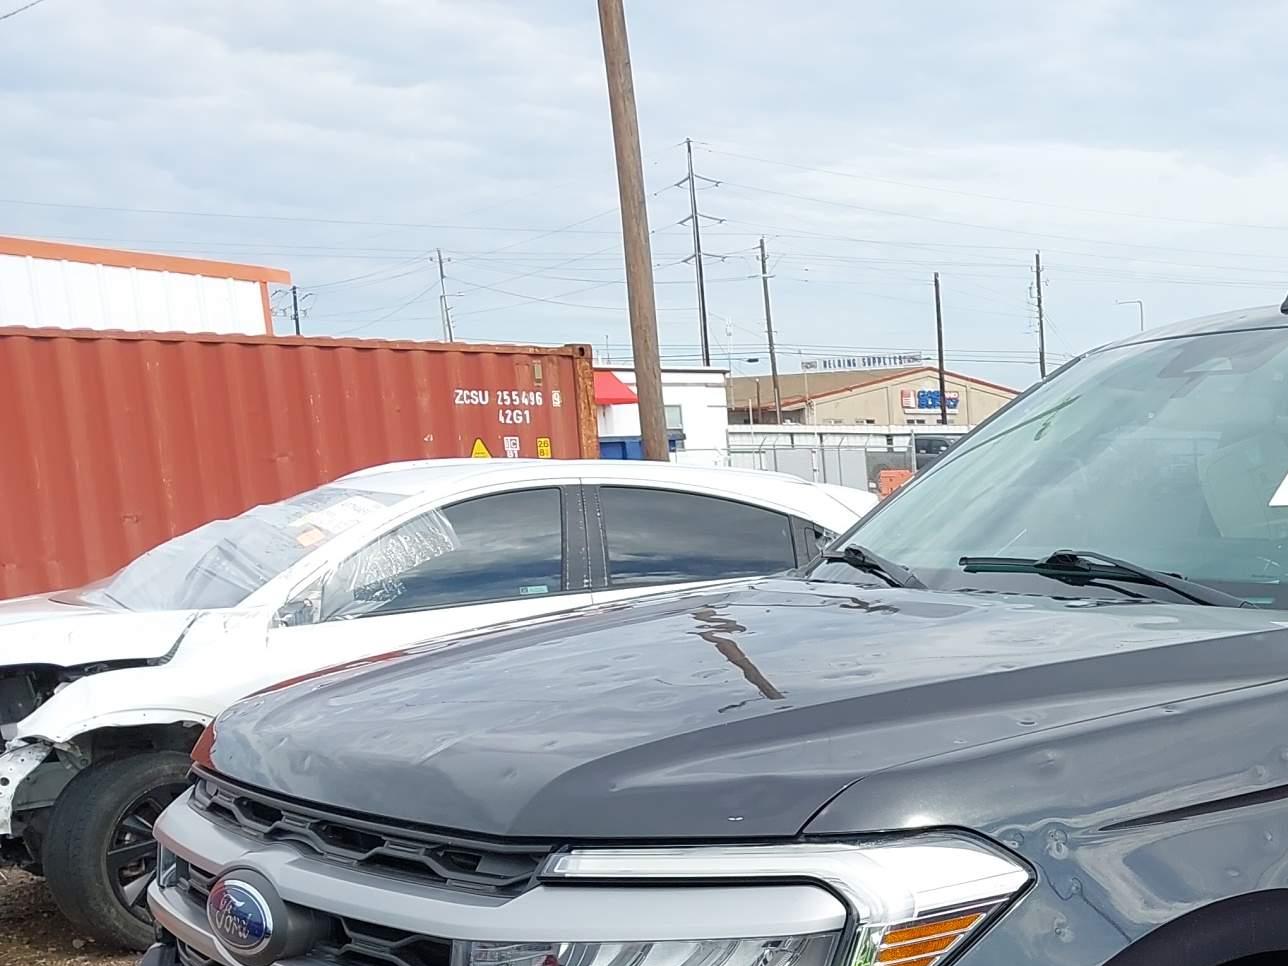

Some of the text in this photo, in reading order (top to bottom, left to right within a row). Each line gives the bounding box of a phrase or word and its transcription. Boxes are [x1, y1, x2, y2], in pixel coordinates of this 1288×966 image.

[862, 355, 903, 367] SUPPLIES
[455, 389, 561, 406] ZCSU 255496 9
[499, 409, 531, 424] 42G1
[215, 891, 252, 939] Ford
